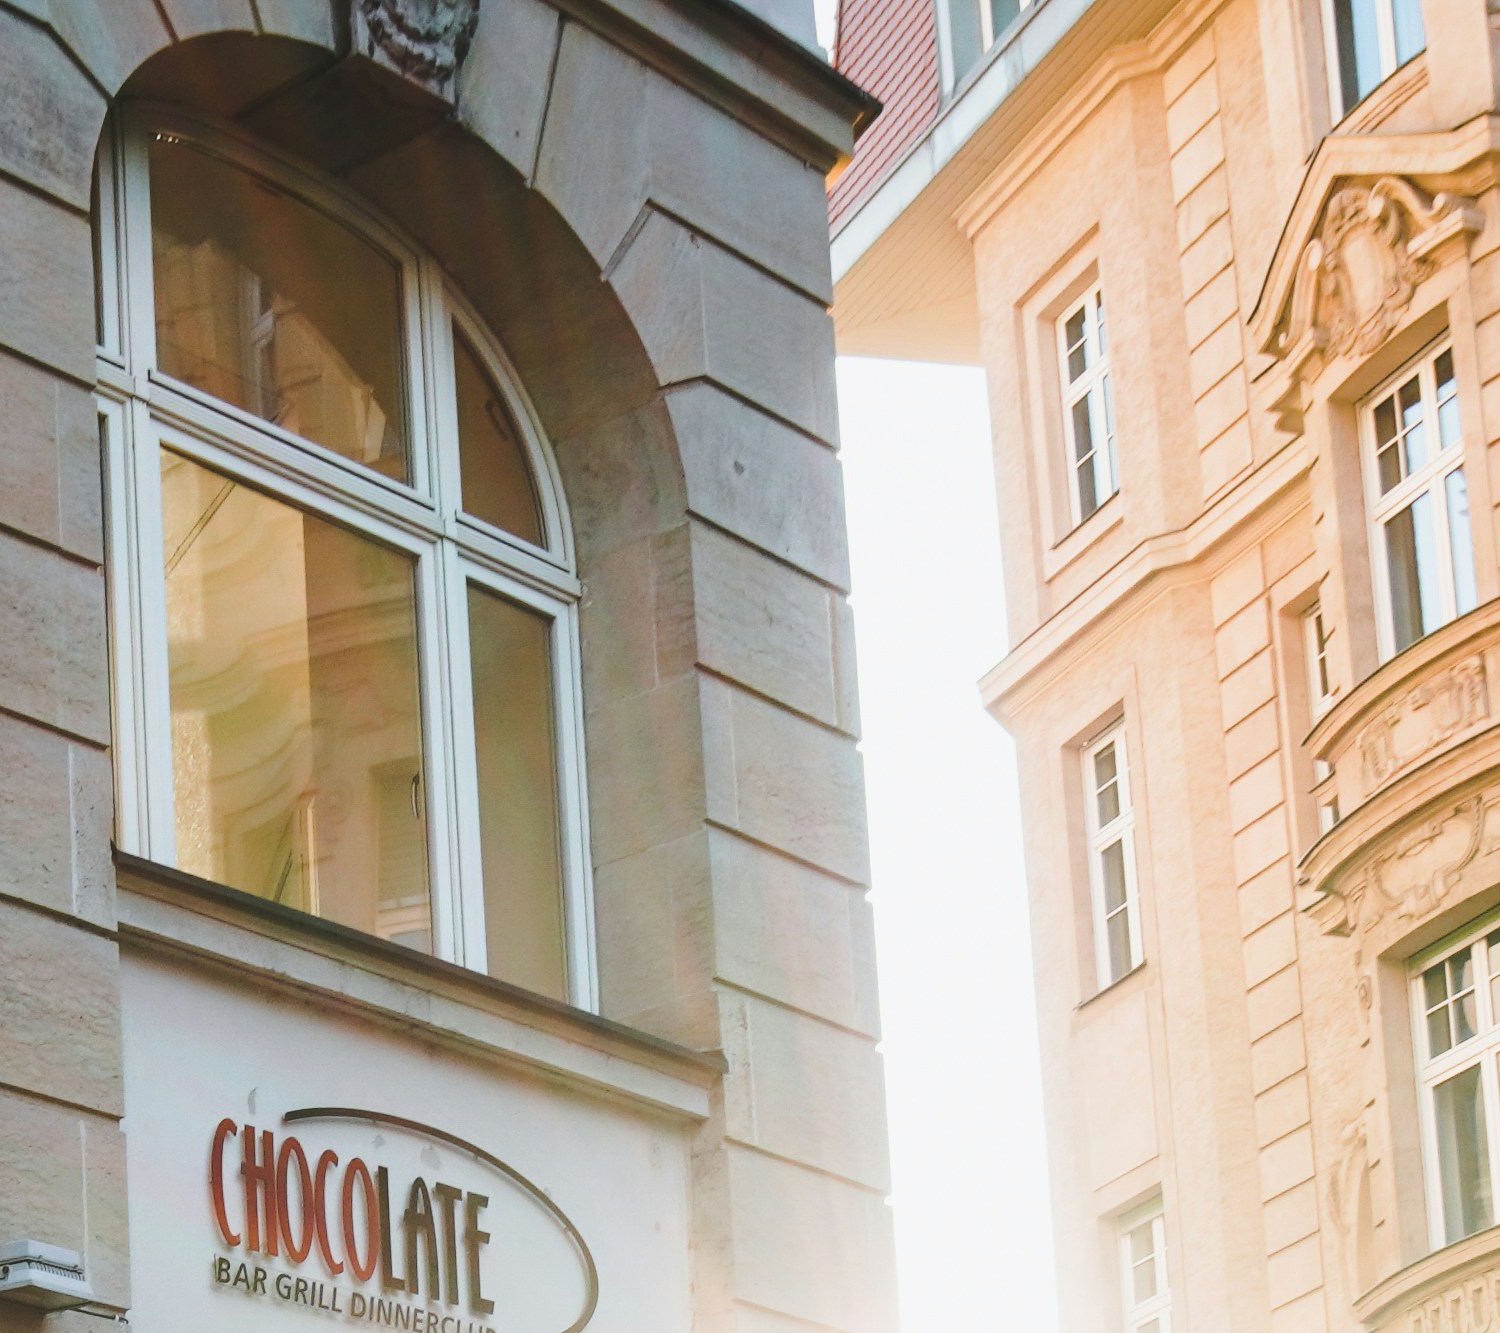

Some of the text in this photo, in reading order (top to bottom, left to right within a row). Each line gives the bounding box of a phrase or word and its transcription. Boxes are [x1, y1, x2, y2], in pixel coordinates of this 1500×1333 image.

[209, 1117, 496, 1315] CHOCOLATE
[217, 1255, 268, 1295] BAR
[275, 1273, 343, 1314] GRILL
